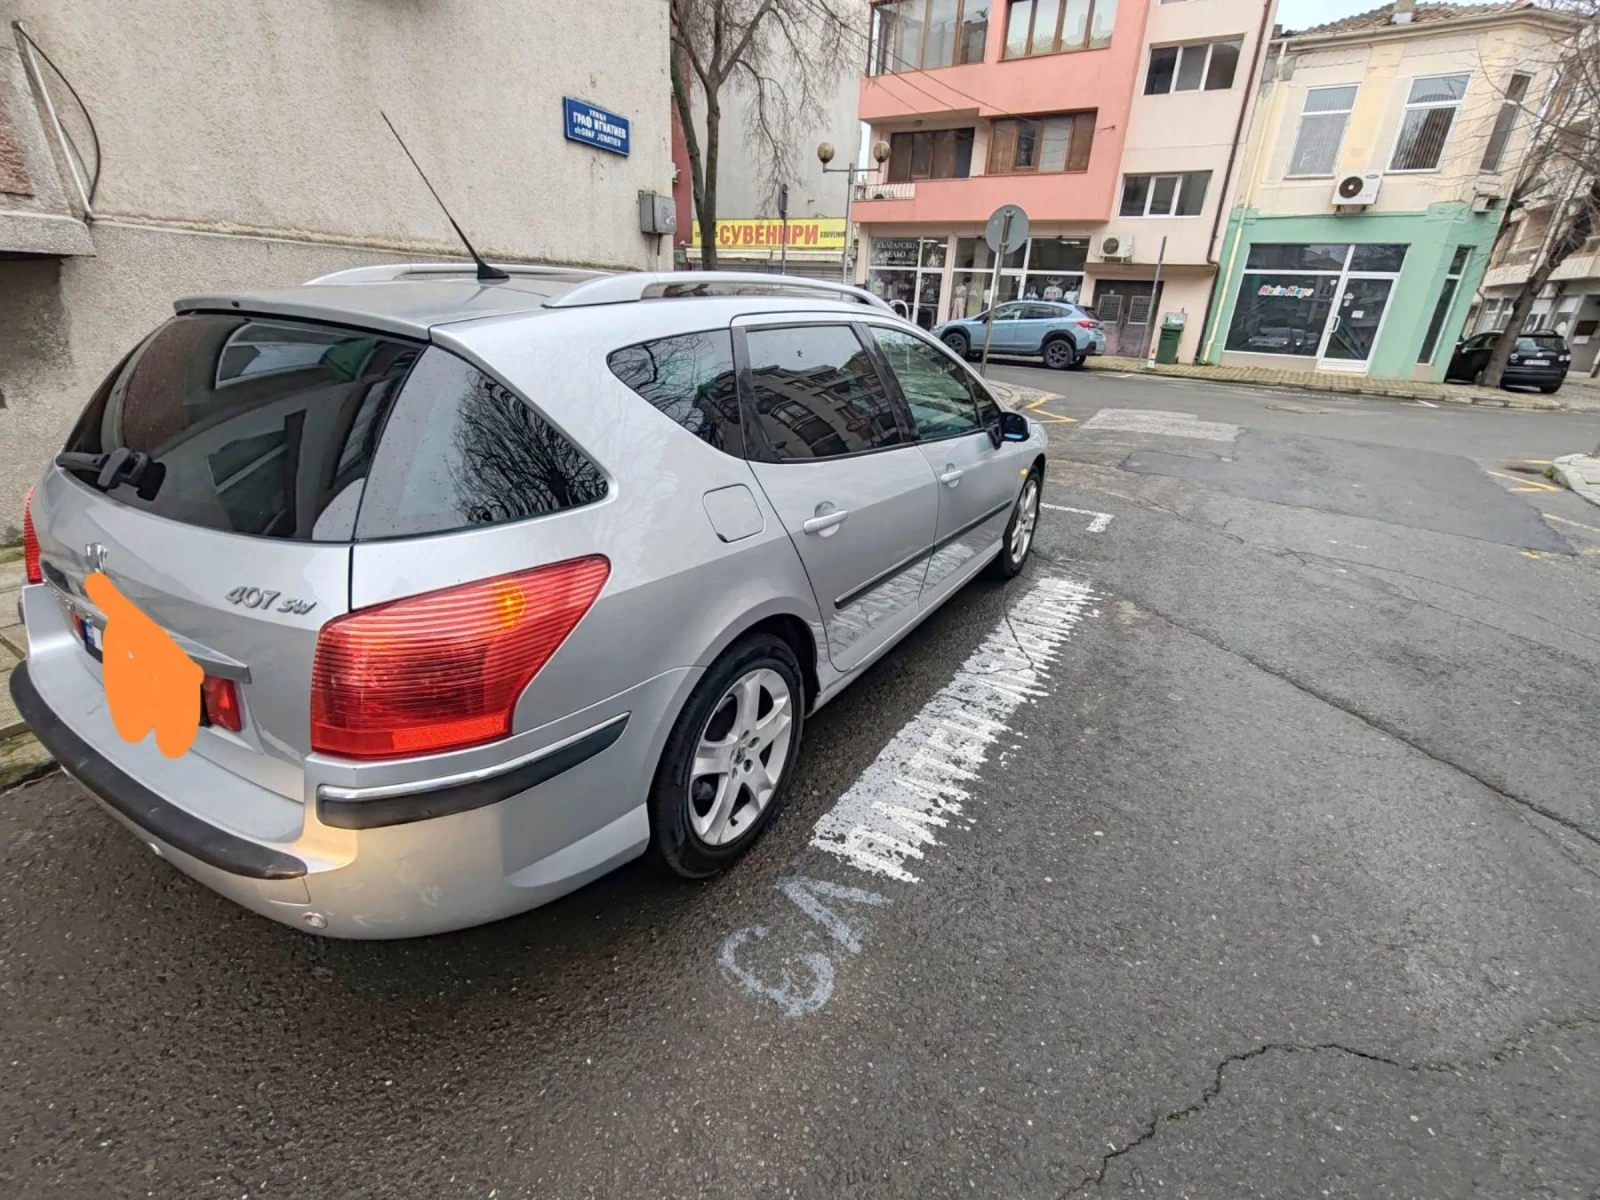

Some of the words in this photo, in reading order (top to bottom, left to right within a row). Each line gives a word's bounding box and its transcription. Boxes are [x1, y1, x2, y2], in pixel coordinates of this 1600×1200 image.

[573, 111, 592, 128] ГРАФ
[594, 119, 626, 139] ИГНАТИЕВ
[719, 224, 819, 245] СУВЕНИРИ
[225, 586, 281, 610] 407
